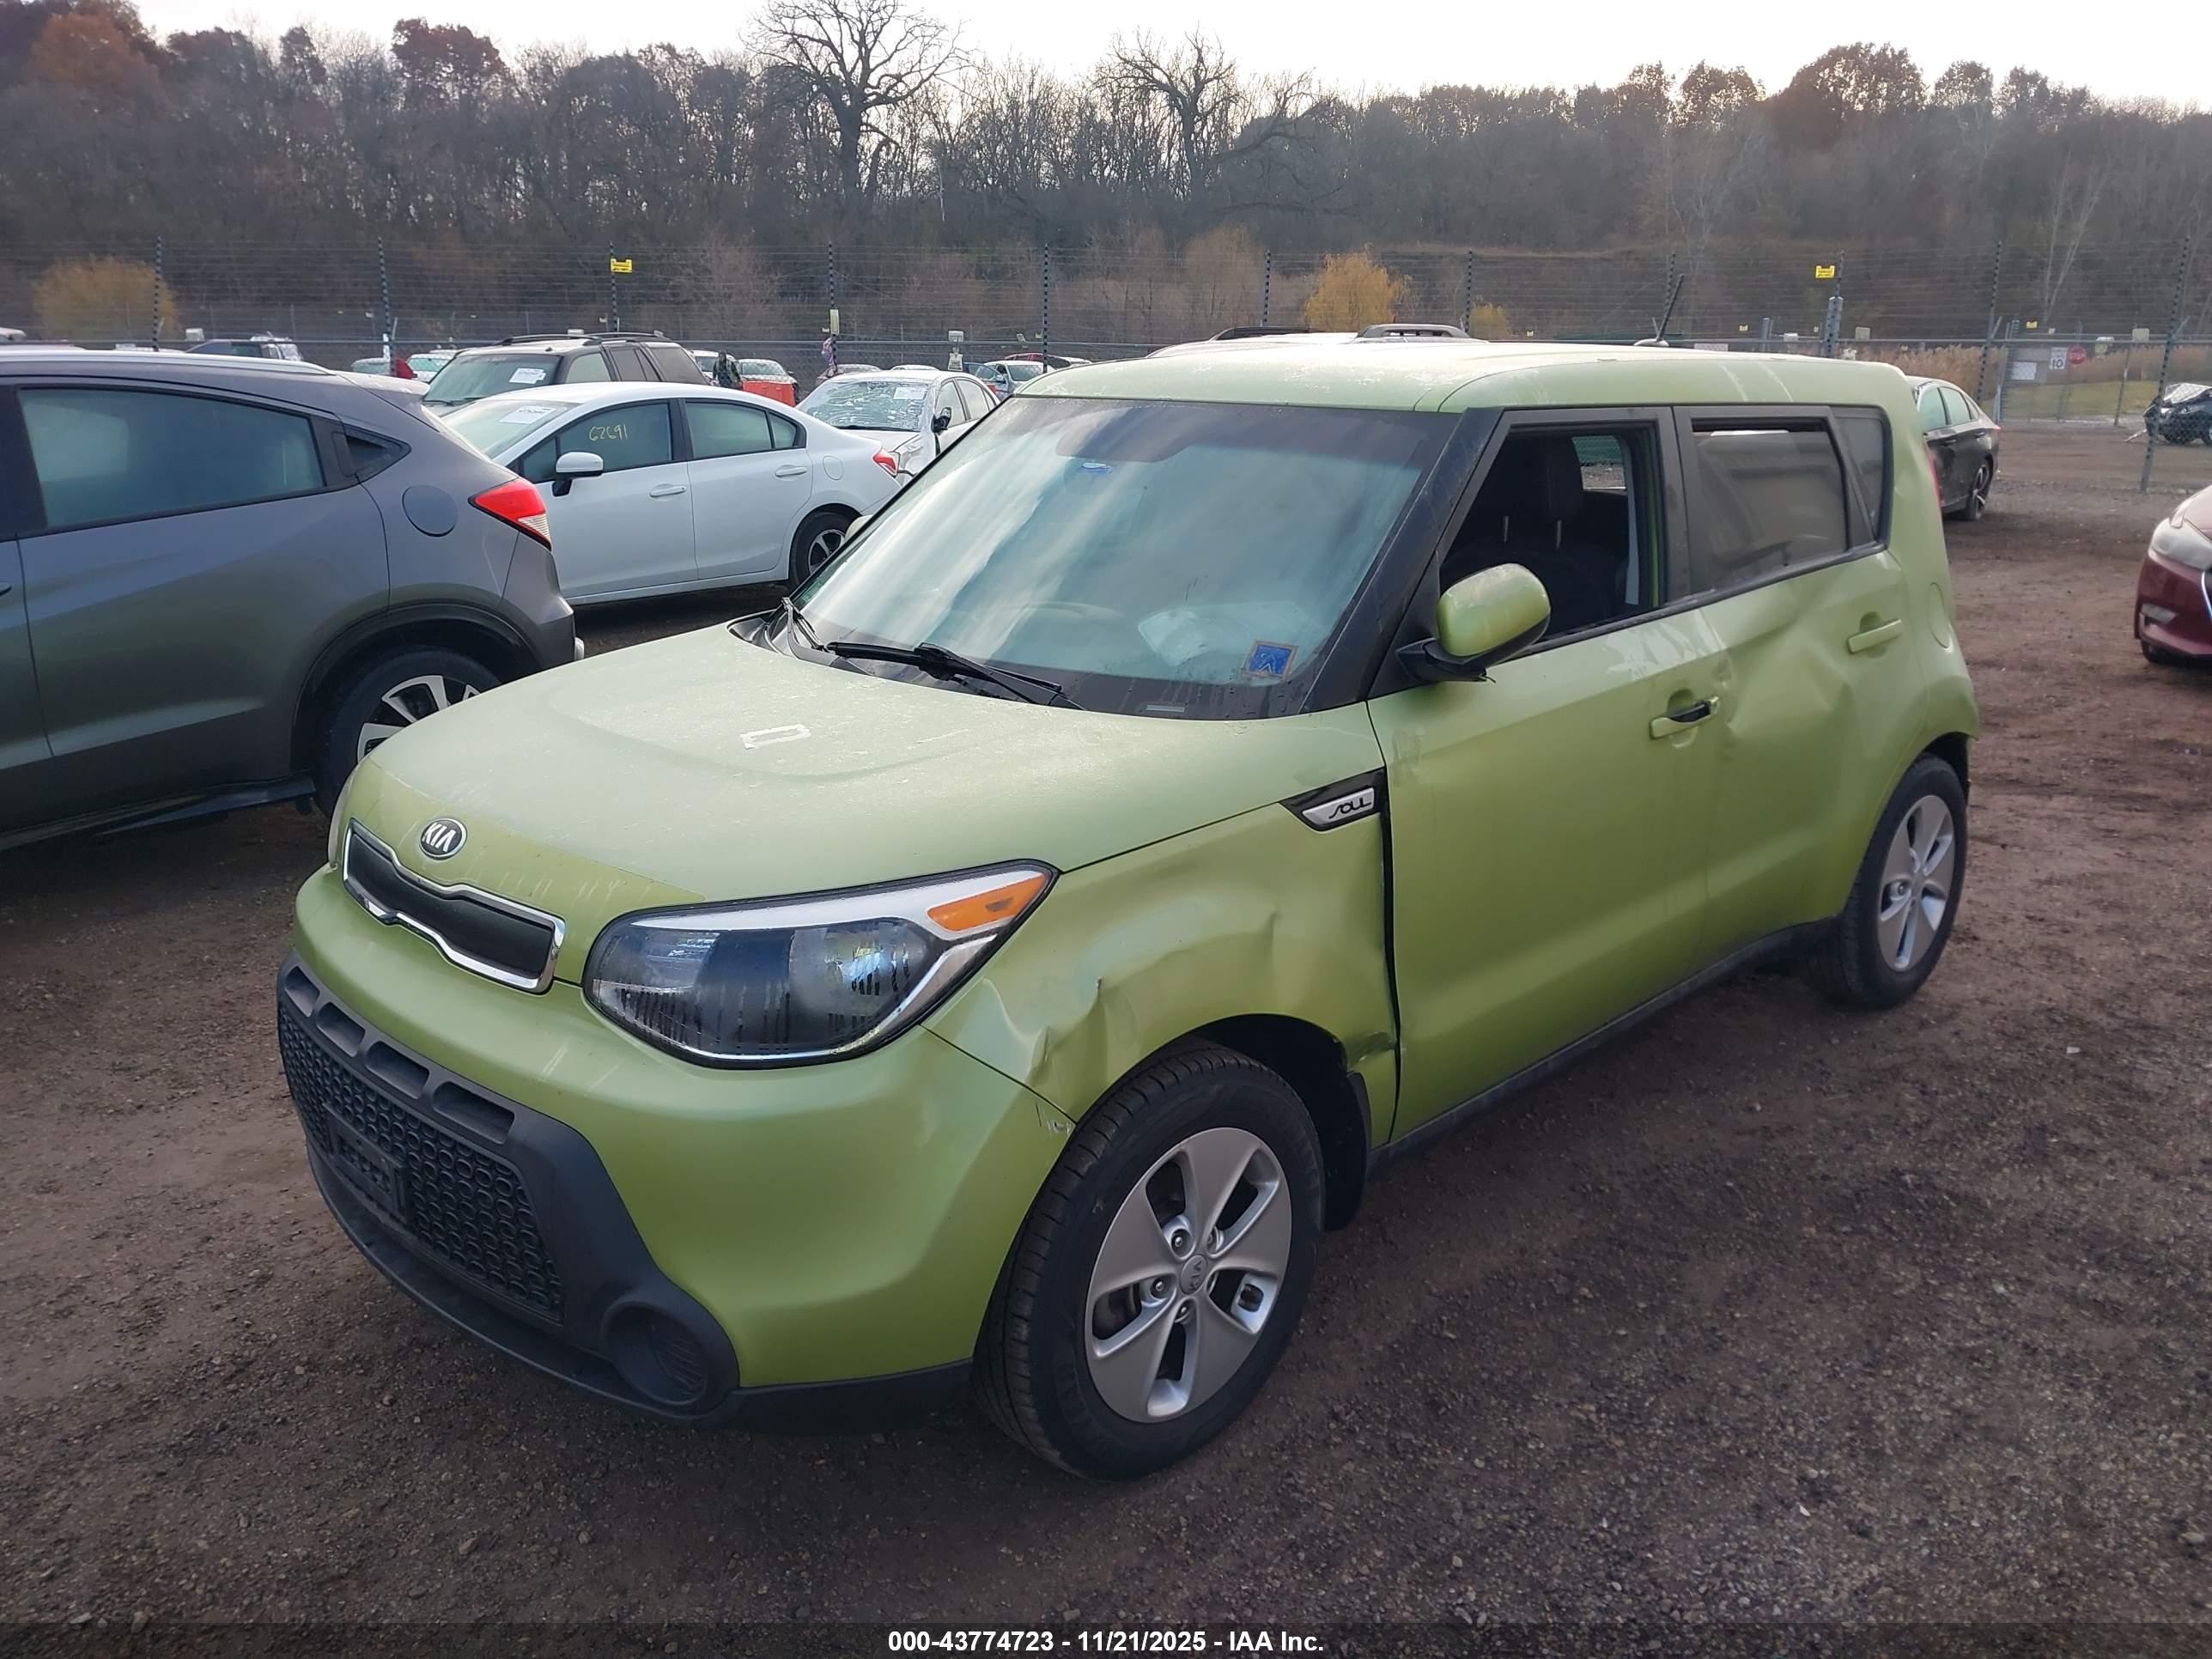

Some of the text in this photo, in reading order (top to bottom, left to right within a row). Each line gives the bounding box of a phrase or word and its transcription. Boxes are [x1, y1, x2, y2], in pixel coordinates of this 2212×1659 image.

[2052, 358, 2063, 368] 10
[1328, 797, 1371, 819] SOUL
[421, 822, 456, 853] KIA
